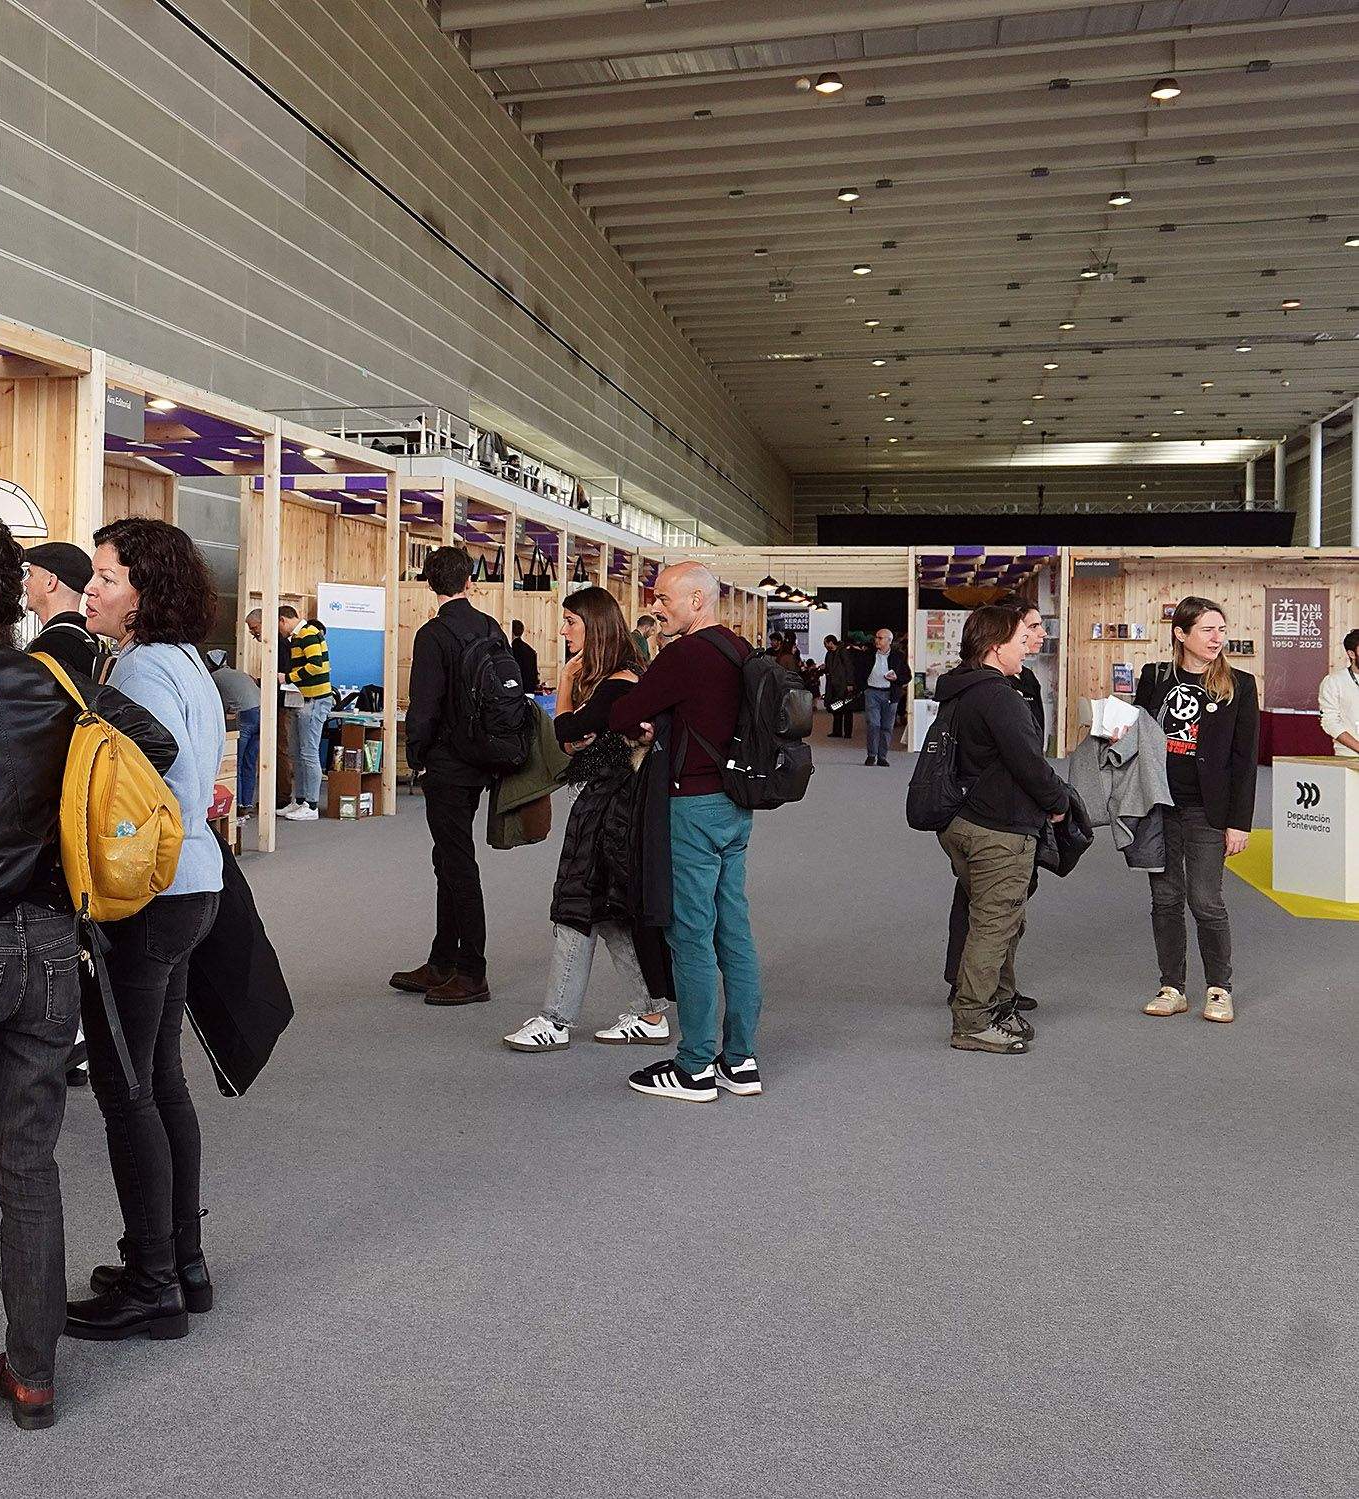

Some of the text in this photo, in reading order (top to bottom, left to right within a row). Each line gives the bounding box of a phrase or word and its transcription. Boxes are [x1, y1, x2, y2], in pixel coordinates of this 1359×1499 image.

[1301, 603, 1321, 612] ANI
[1278, 612, 1295, 621] 75
[1301, 611, 1323, 620] VER
[1301, 619, 1317, 628] SA
[1301, 627, 1322, 636] RIO
[1287, 811, 1331, 824] Deputación
[1287, 820, 1331, 833] Pontevedra
